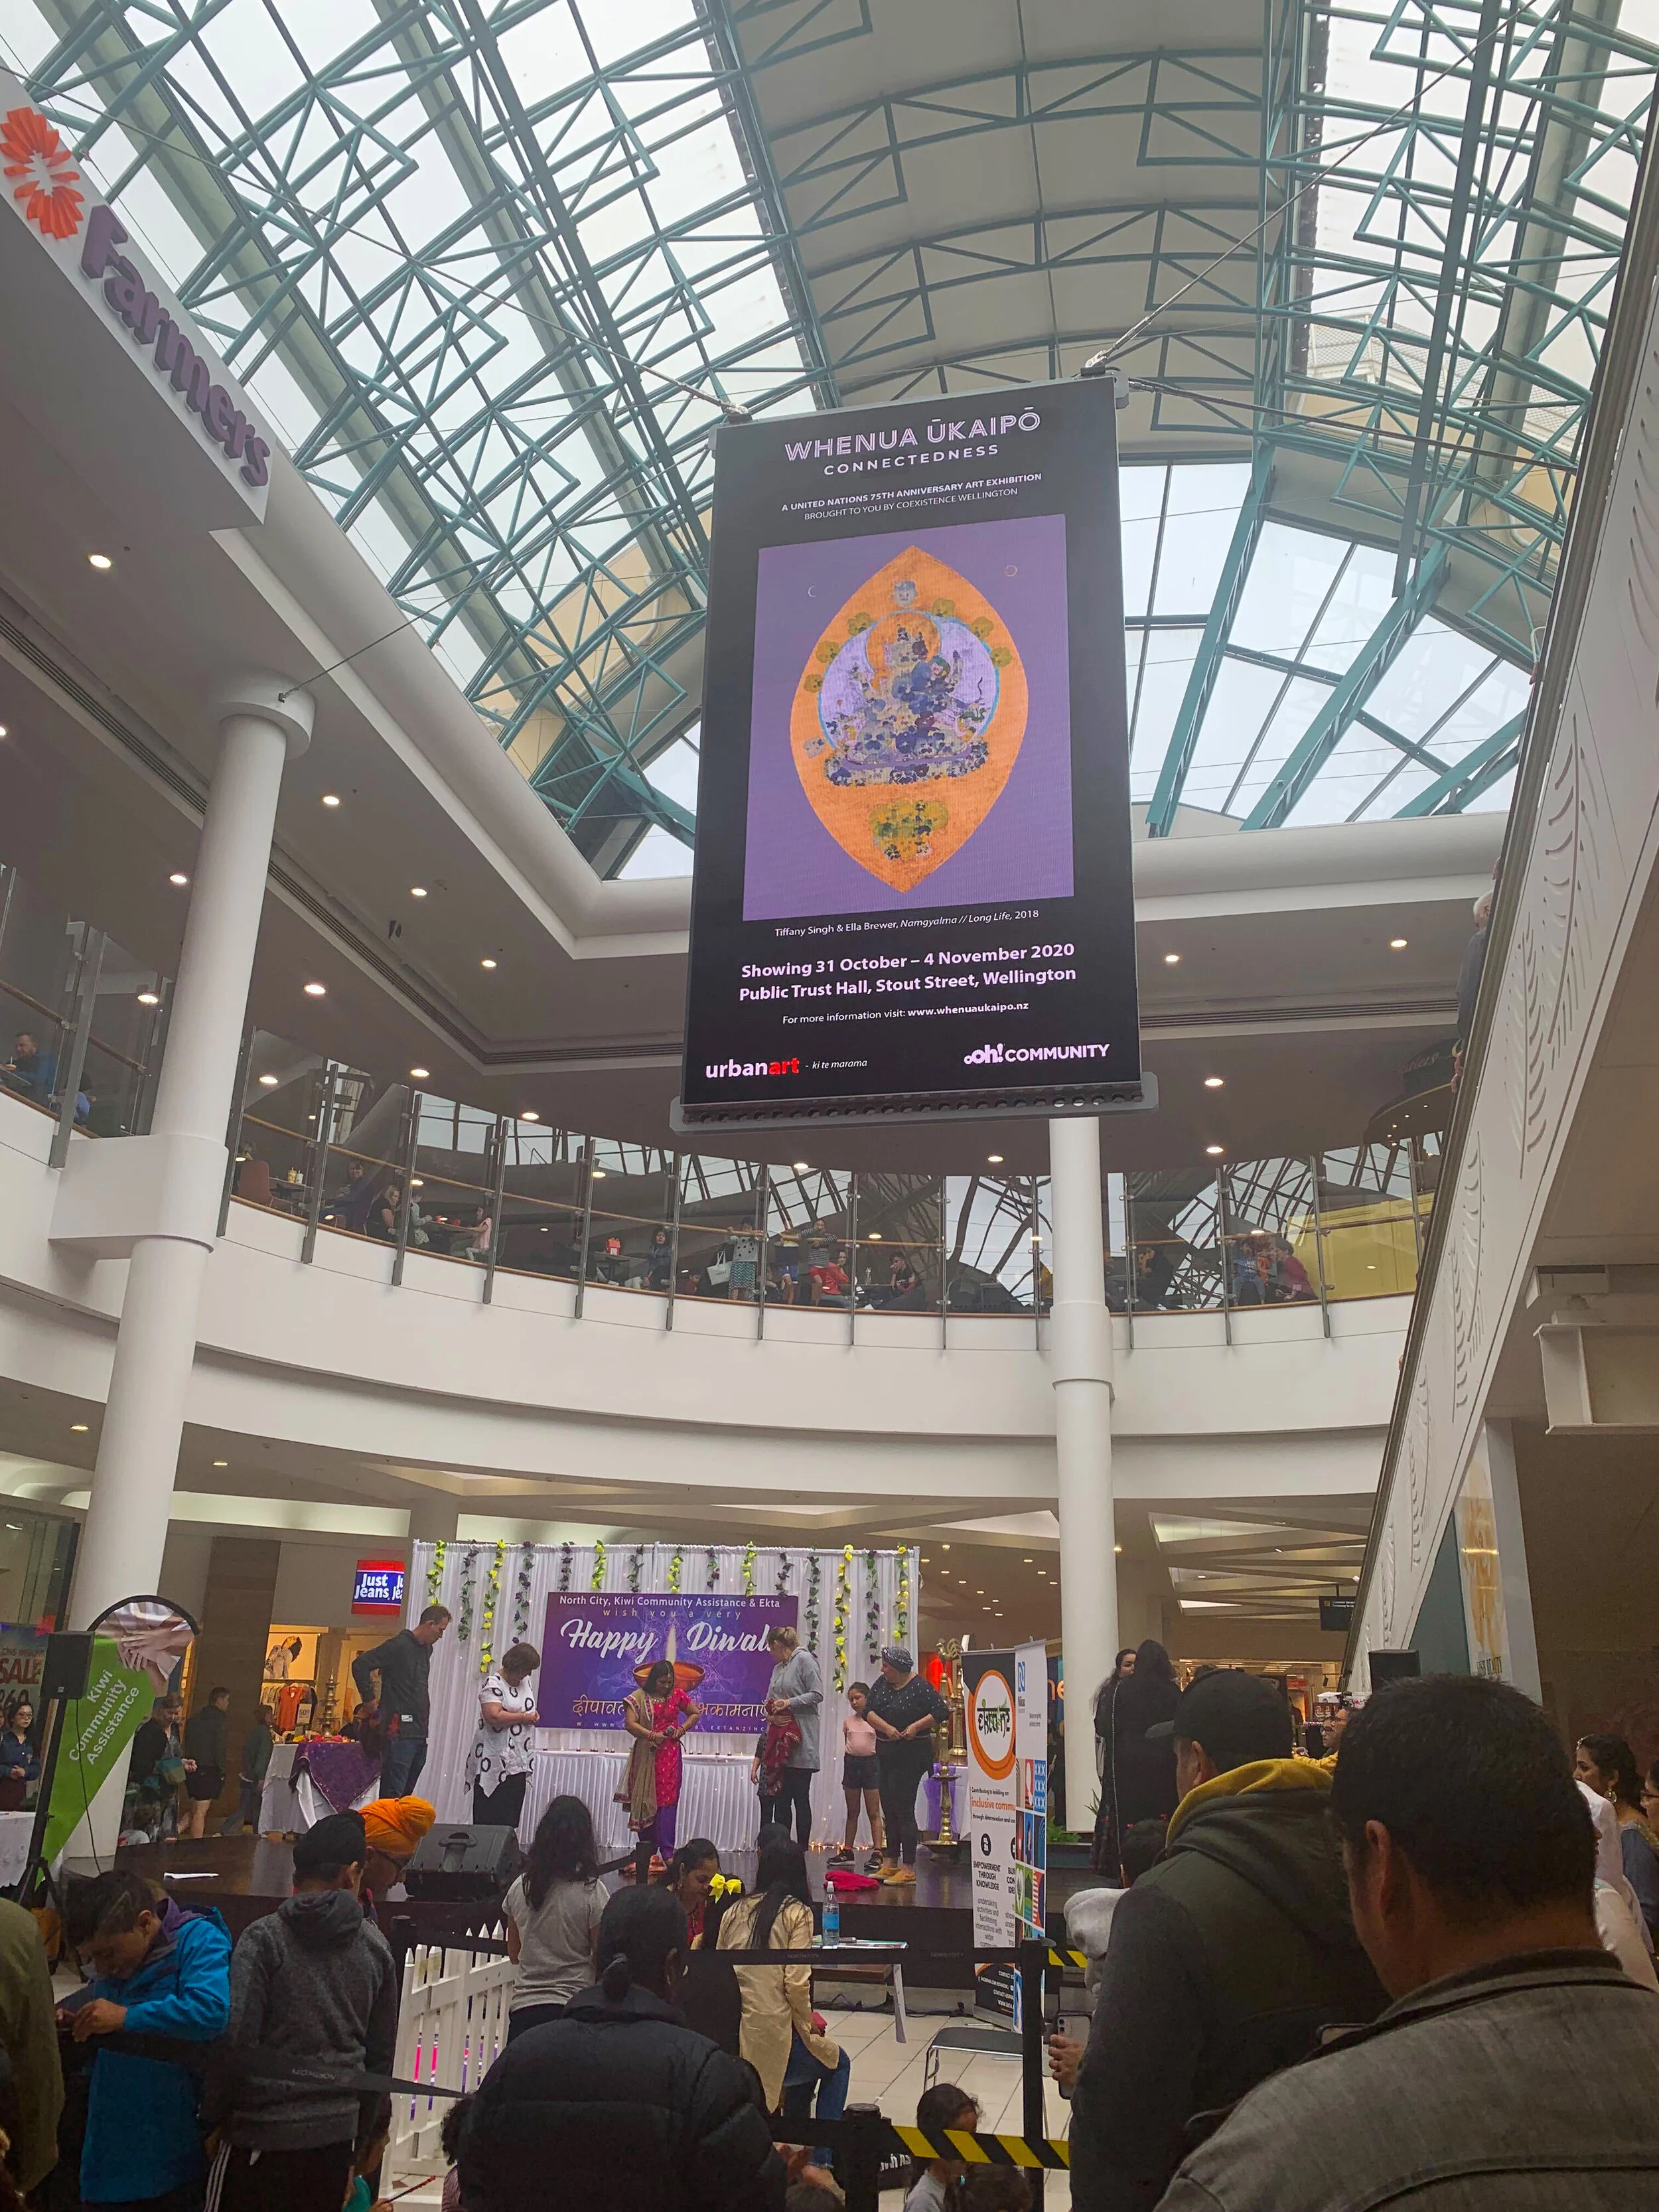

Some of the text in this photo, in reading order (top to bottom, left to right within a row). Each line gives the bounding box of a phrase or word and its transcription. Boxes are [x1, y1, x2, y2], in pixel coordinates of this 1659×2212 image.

[80, 204, 271, 487] Farmers
[784, 406, 1041, 461] WHENUA ŪKAIPŌ
[824, 444, 998, 475] CONNECTEDNESS
[790, 500, 826, 510] UNITED
[827, 494, 869, 506] NATIONS
[871, 491, 895, 500] 75TH
[896, 482, 964, 498] ANNIVERSARY
[965, 480, 985, 489] ART
[986, 473, 1042, 486] EXHIBITION
[804, 508, 848, 520] BROUGHT
[863, 504, 881, 514] YOU
[896, 495, 957, 509] COEXISTENCE
[958, 488, 1018, 501] WELLINGTON
[775, 927, 806, 937] Tiffany
[808, 924, 834, 935] Singh
[846, 922, 862, 931] Ella
[864, 921, 899, 930] Brewer,
[901, 916, 958, 928] Namgyalma
[958, 915, 968, 924] //
[968, 913, 992, 923] Long
[993, 912, 1013, 921] Life,
[1015, 910, 1039, 919] 2018
[741, 962, 812, 978] Showing
[815, 960, 835, 973] 31
[839, 956, 908, 971] October
[923, 952, 934, 965] 4
[938, 947, 1027, 965] November
[1031, 943, 1075, 958] 2020
[739, 968, 1076, 1001] Public Trust Hall, Stout Street, Wellington
[800, 1015, 824, 1023] more
[826, 1011, 881, 1022] information
[884, 1009, 906, 1018] visit:
[907, 1002, 1029, 1017] www.whenuaukaipo.nz
[1005, 1044, 1110, 1062] COMMUNITY
[705, 1057, 800, 1078] urbanart
[812, 1061, 820, 1070] ki
[822, 1061, 829, 1069] te
[830, 1059, 868, 1069] marama
[354, 1585, 390, 1599] Jeans
[361, 1573, 389, 1588] Just
[559, 1595, 780, 1609] North City, Kiwi Community Assistance & Ekta
[603, 1607, 638, 1617] wish
[650, 1610, 677, 1619] you
[706, 1611, 742, 1621] very
[560, 1619, 772, 1664] Happy Diwal
[0, 1658, 44, 1684] SALE
[86, 1669, 113, 1703] Kiwi
[68, 1678, 127, 1761] Community
[86, 1687, 139, 1765] Assistance
[971, 1797, 1016, 1811] inclusive commu
[975, 1880, 999, 1891] KNOWLEDGE
[978, 1870, 997, 1881] THROUGH
